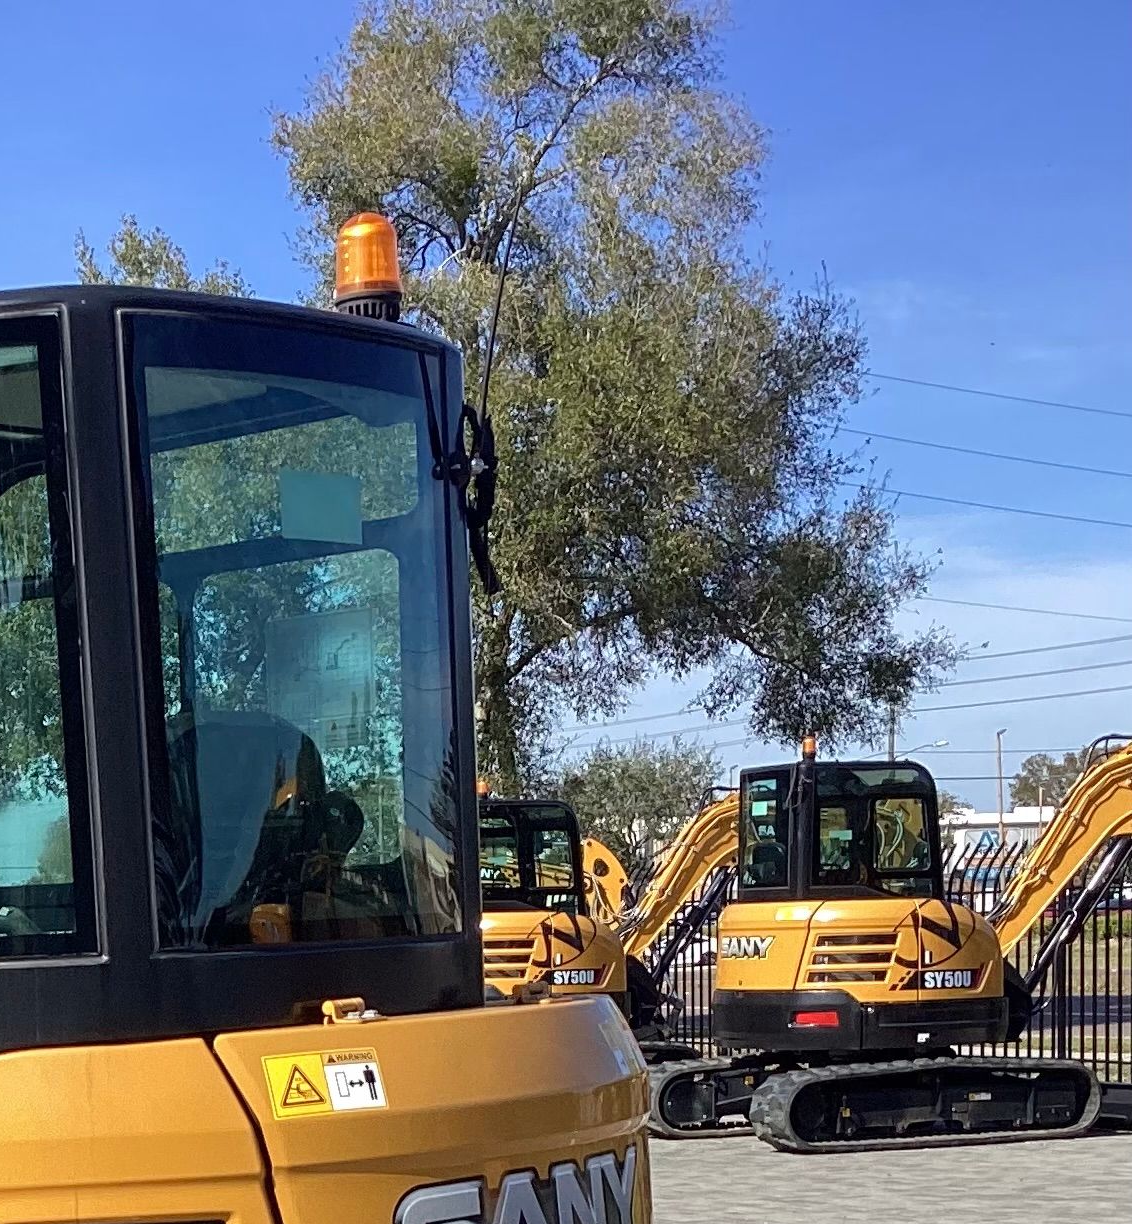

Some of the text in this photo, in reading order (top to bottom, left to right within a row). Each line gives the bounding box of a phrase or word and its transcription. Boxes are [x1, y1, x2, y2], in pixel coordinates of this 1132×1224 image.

[553, 969, 595, 985] SY50U
[924, 970, 972, 989] SY50U
[336, 1051, 373, 1062] WARNING
